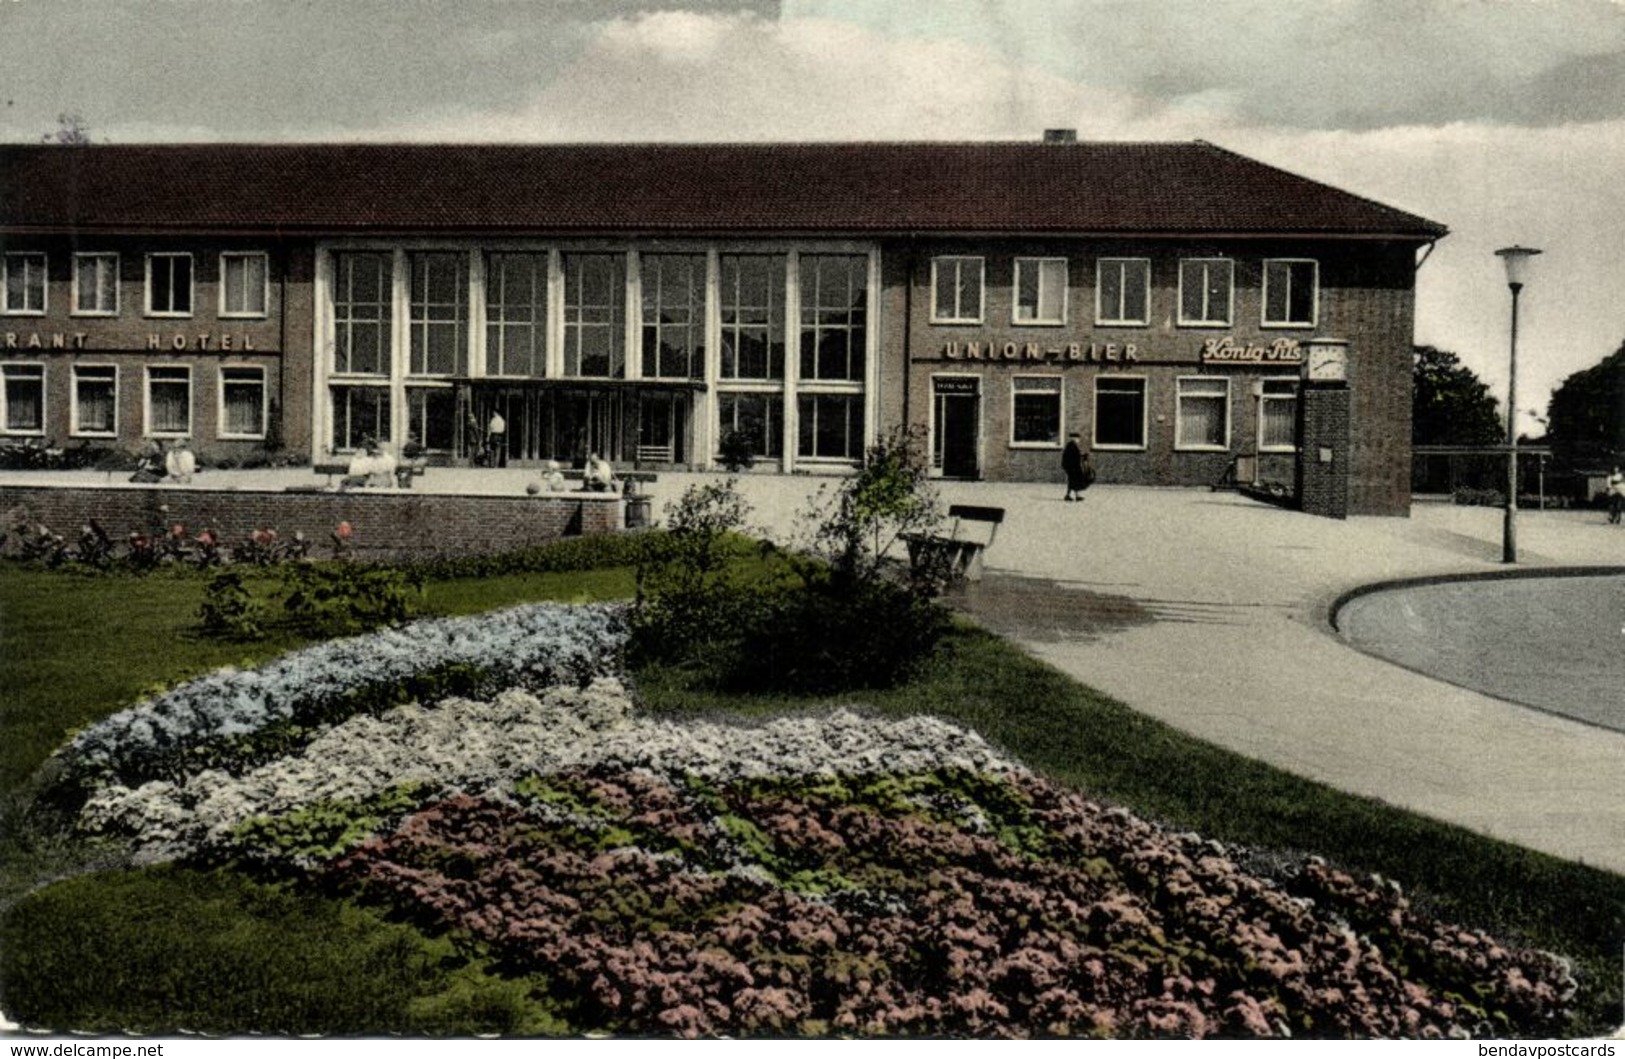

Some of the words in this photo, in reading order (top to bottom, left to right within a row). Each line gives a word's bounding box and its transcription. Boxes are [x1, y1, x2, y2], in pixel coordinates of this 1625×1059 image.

[5, 332, 87, 349] RANT
[148, 333, 254, 350] HOTEL
[946, 341, 1138, 360] UNION-BIER
